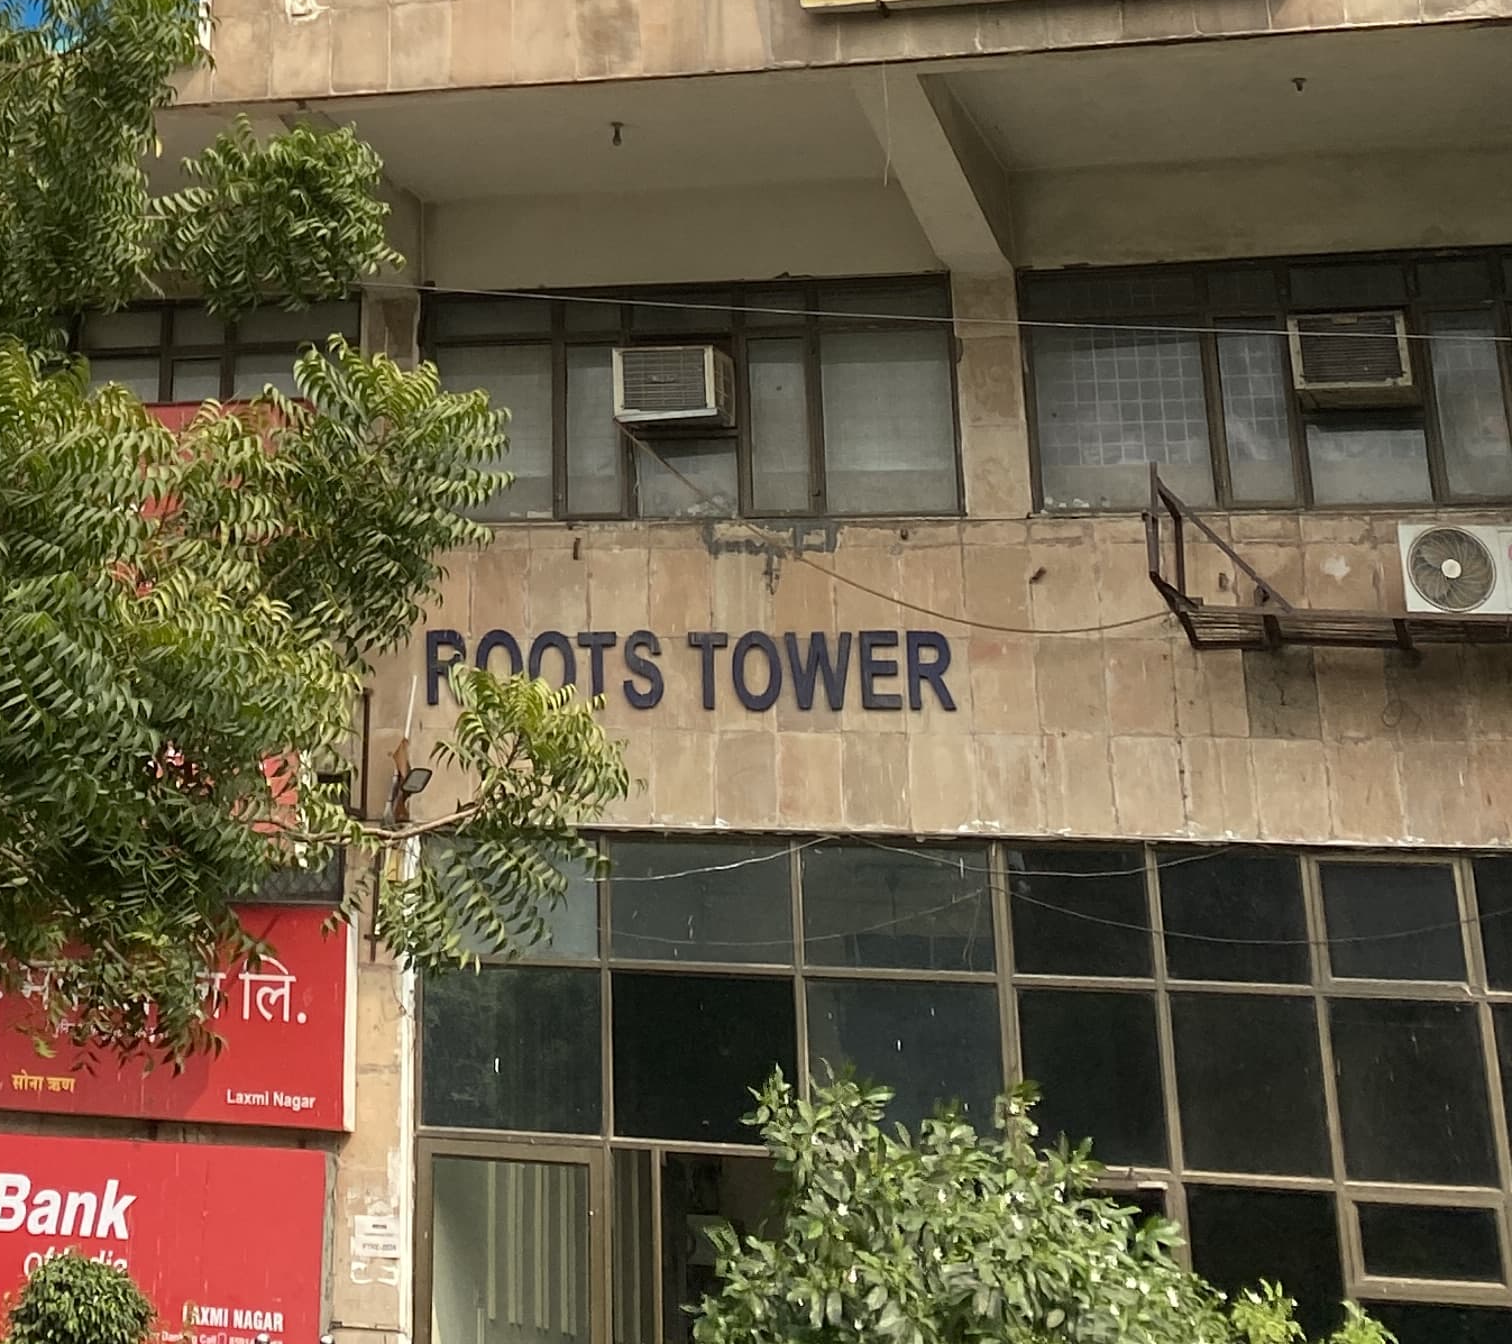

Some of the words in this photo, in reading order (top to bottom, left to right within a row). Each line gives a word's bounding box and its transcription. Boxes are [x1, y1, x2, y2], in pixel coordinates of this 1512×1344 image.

[425, 629, 665, 709] ROOTS
[689, 629, 957, 712] TOWER
[11, 1069, 44, 1092] सोना
[227, 1088, 270, 1108] Laxmi
[273, 1091, 316, 1112] Nagar
[233, 1308, 284, 1332] NAGAR
